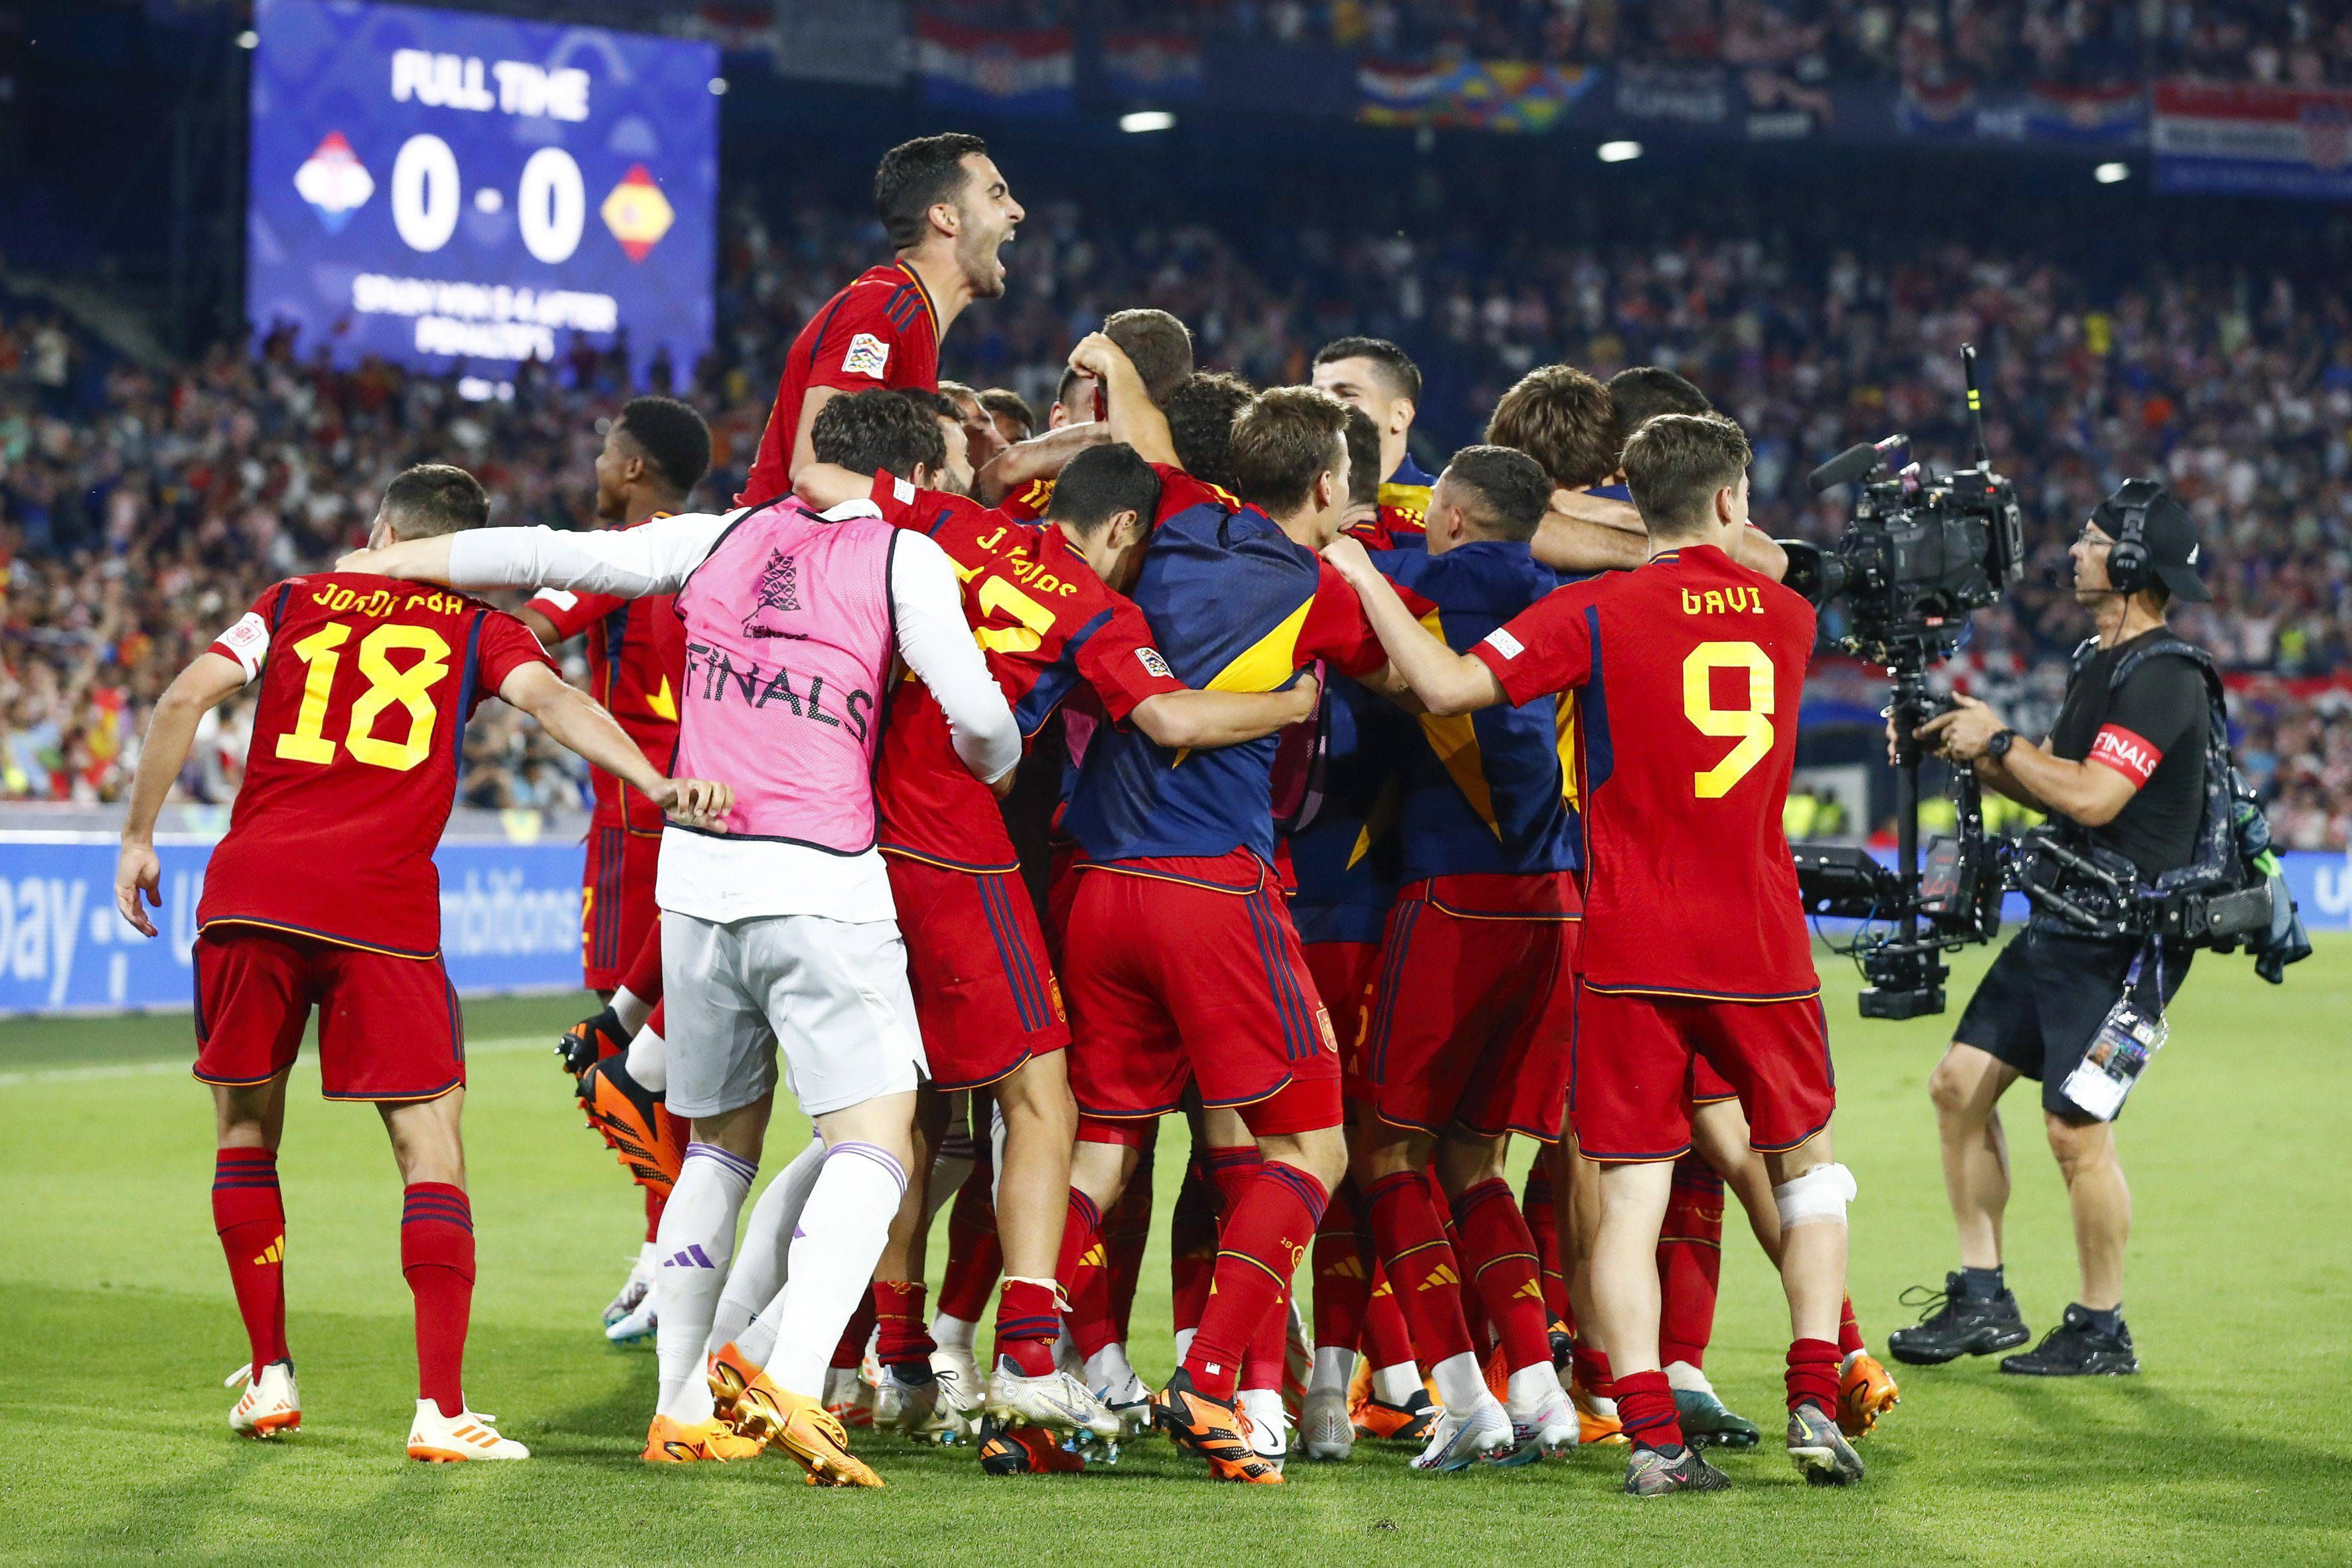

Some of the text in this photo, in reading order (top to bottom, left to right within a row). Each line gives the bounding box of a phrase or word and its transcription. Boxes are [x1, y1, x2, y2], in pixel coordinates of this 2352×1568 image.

[393, 49, 589, 121] FULL TIME
[392, 133, 460, 252] 0
[518, 147, 586, 264] 0
[1682, 587, 1764, 615] GAVI
[275, 621, 451, 771] 18
[686, 643, 874, 742] FINALS
[1682, 641, 1774, 798] 9
[2092, 732, 2157, 778] FINALS
